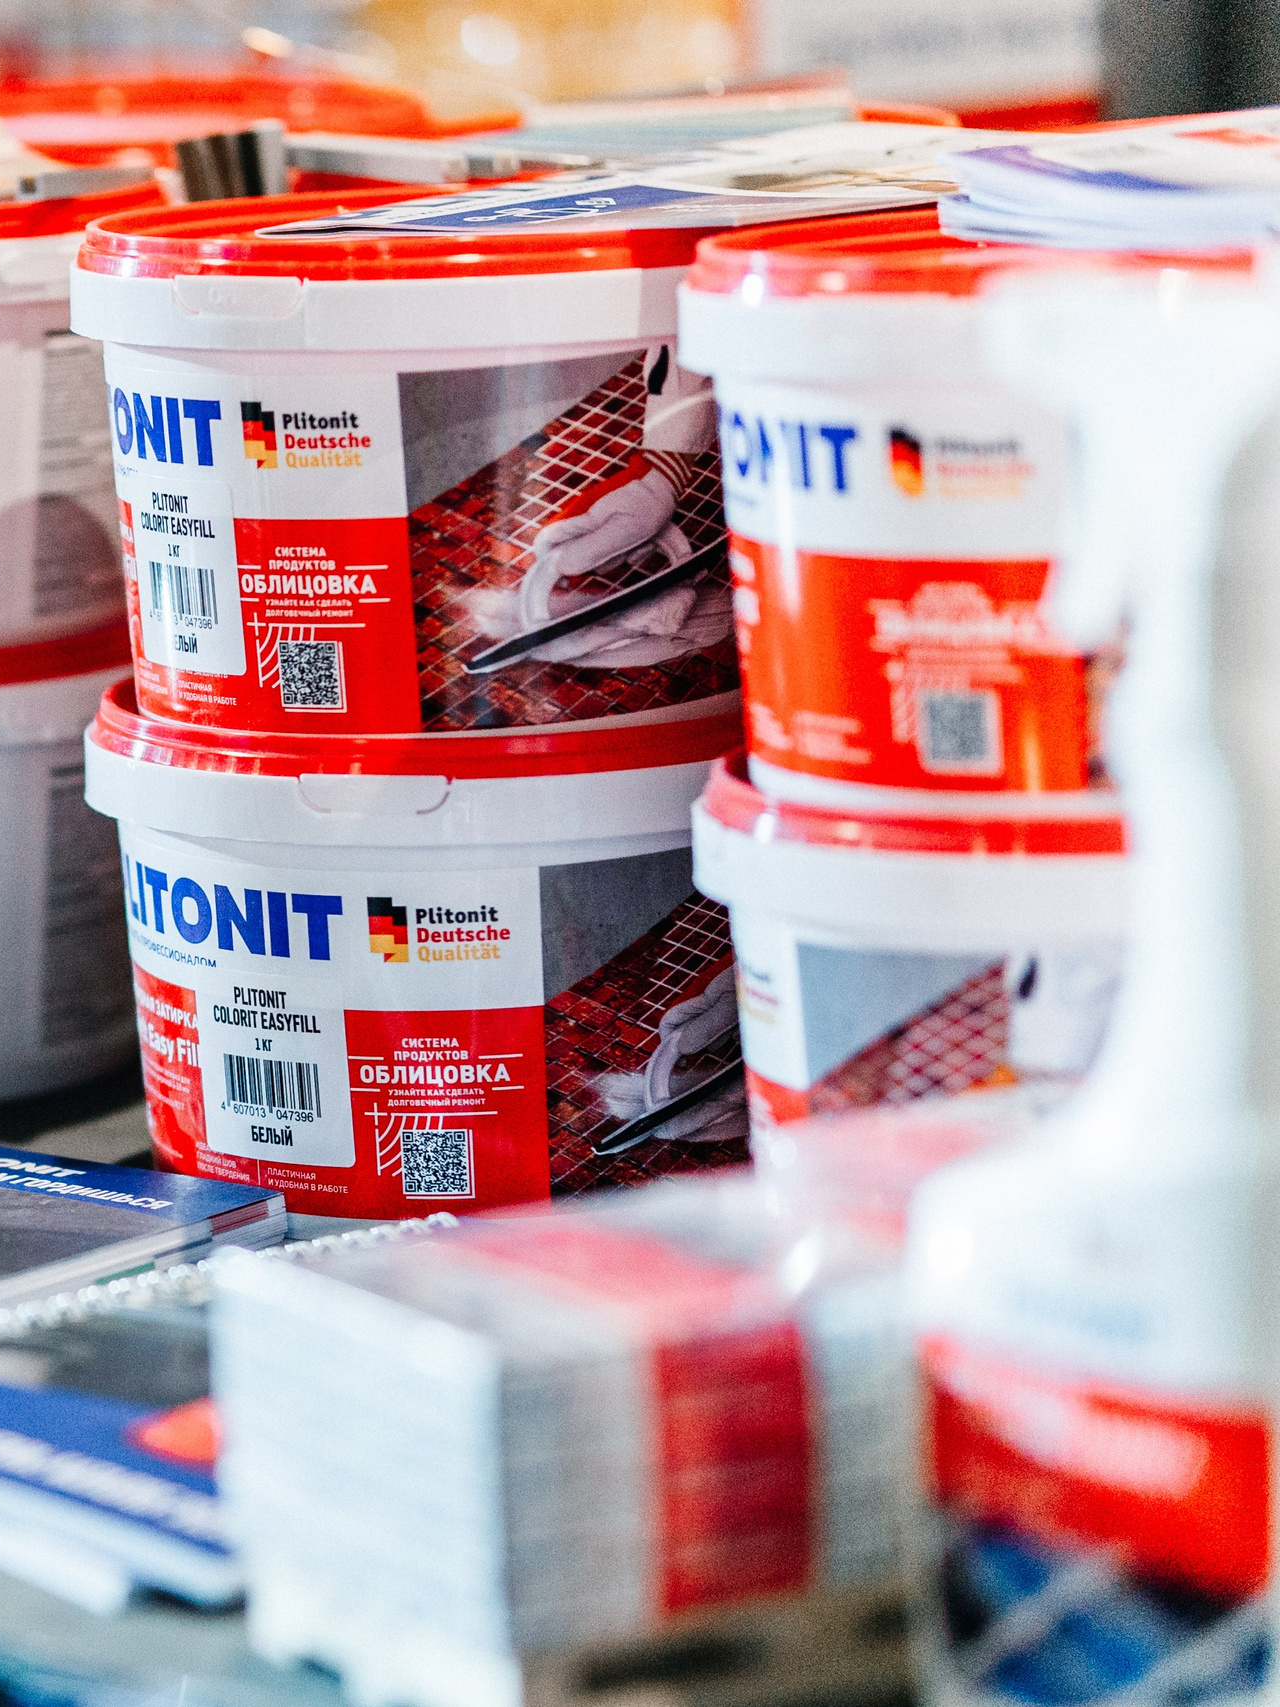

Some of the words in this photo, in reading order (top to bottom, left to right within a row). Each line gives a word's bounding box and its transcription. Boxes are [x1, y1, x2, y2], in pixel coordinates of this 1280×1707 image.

[107, 383, 221, 466] ONIT
[282, 411, 359, 430] Plitonit
[284, 432, 371, 449] Deutsche
[285, 450, 362, 468] Qualität
[152, 492, 188, 514] PLITONIT
[141, 512, 169, 534] COLORIT
[171, 518, 215, 538] EASYFILL
[168, 544, 172, 557] 1
[173, 545, 180, 558] КГ
[275, 546, 327, 557] СИСТЕМА
[268, 560, 336, 572] ПРОДУКТОВ
[241, 574, 377, 598] ОБЛИЦОВКА
[184, 616, 213, 630] 047396
[174, 633, 199, 654] ЕЛЫЙ
[213, 696, 237, 706] РАБОТЕ
[123, 852, 343, 961] LITONIT
[415, 905, 499, 925] Plitonit
[416, 925, 510, 944] Deutsche
[417, 944, 501, 962] Qualität
[233, 986, 286, 1009] PLITONIT
[155, 999, 198, 1029] ЗАТИРКА
[214, 1005, 257, 1029] COLORIT
[261, 1013, 321, 1034] EASYFILL
[148, 1022, 175, 1063] Easy
[255, 1038, 261, 1050] 1
[262, 1039, 272, 1052] КГ
[401, 1037, 459, 1048] СИСТЕМА
[394, 1050, 469, 1063] ПРОДУКТОВ
[360, 1063, 510, 1087] ОБЛИЦОВКА
[388, 1088, 426, 1096] УЗНАЙТЕ
[446, 1088, 484, 1097] СДЕЛАТЬ
[388, 1097, 450, 1106] ДОЛГОВЕЧНЫЙ
[452, 1098, 486, 1106] РЕМОНТ
[221, 1101, 226, 1111] 4
[233, 1104, 267, 1118] 607013
[276, 1110, 314, 1123] 047396
[251, 1125, 293, 1146] БЕЛЫЙ
[267, 1167, 316, 1180] ПЛАСТИЧНАЯ
[15, 1176, 174, 1211] ГОРДИШЬСЯ
[268, 1178, 273, 1186] И
[274, 1179, 309, 1190] УДОБНАЯ
[310, 1183, 316, 1191] В
[318, 1184, 348, 1194] РАБОТЕ
